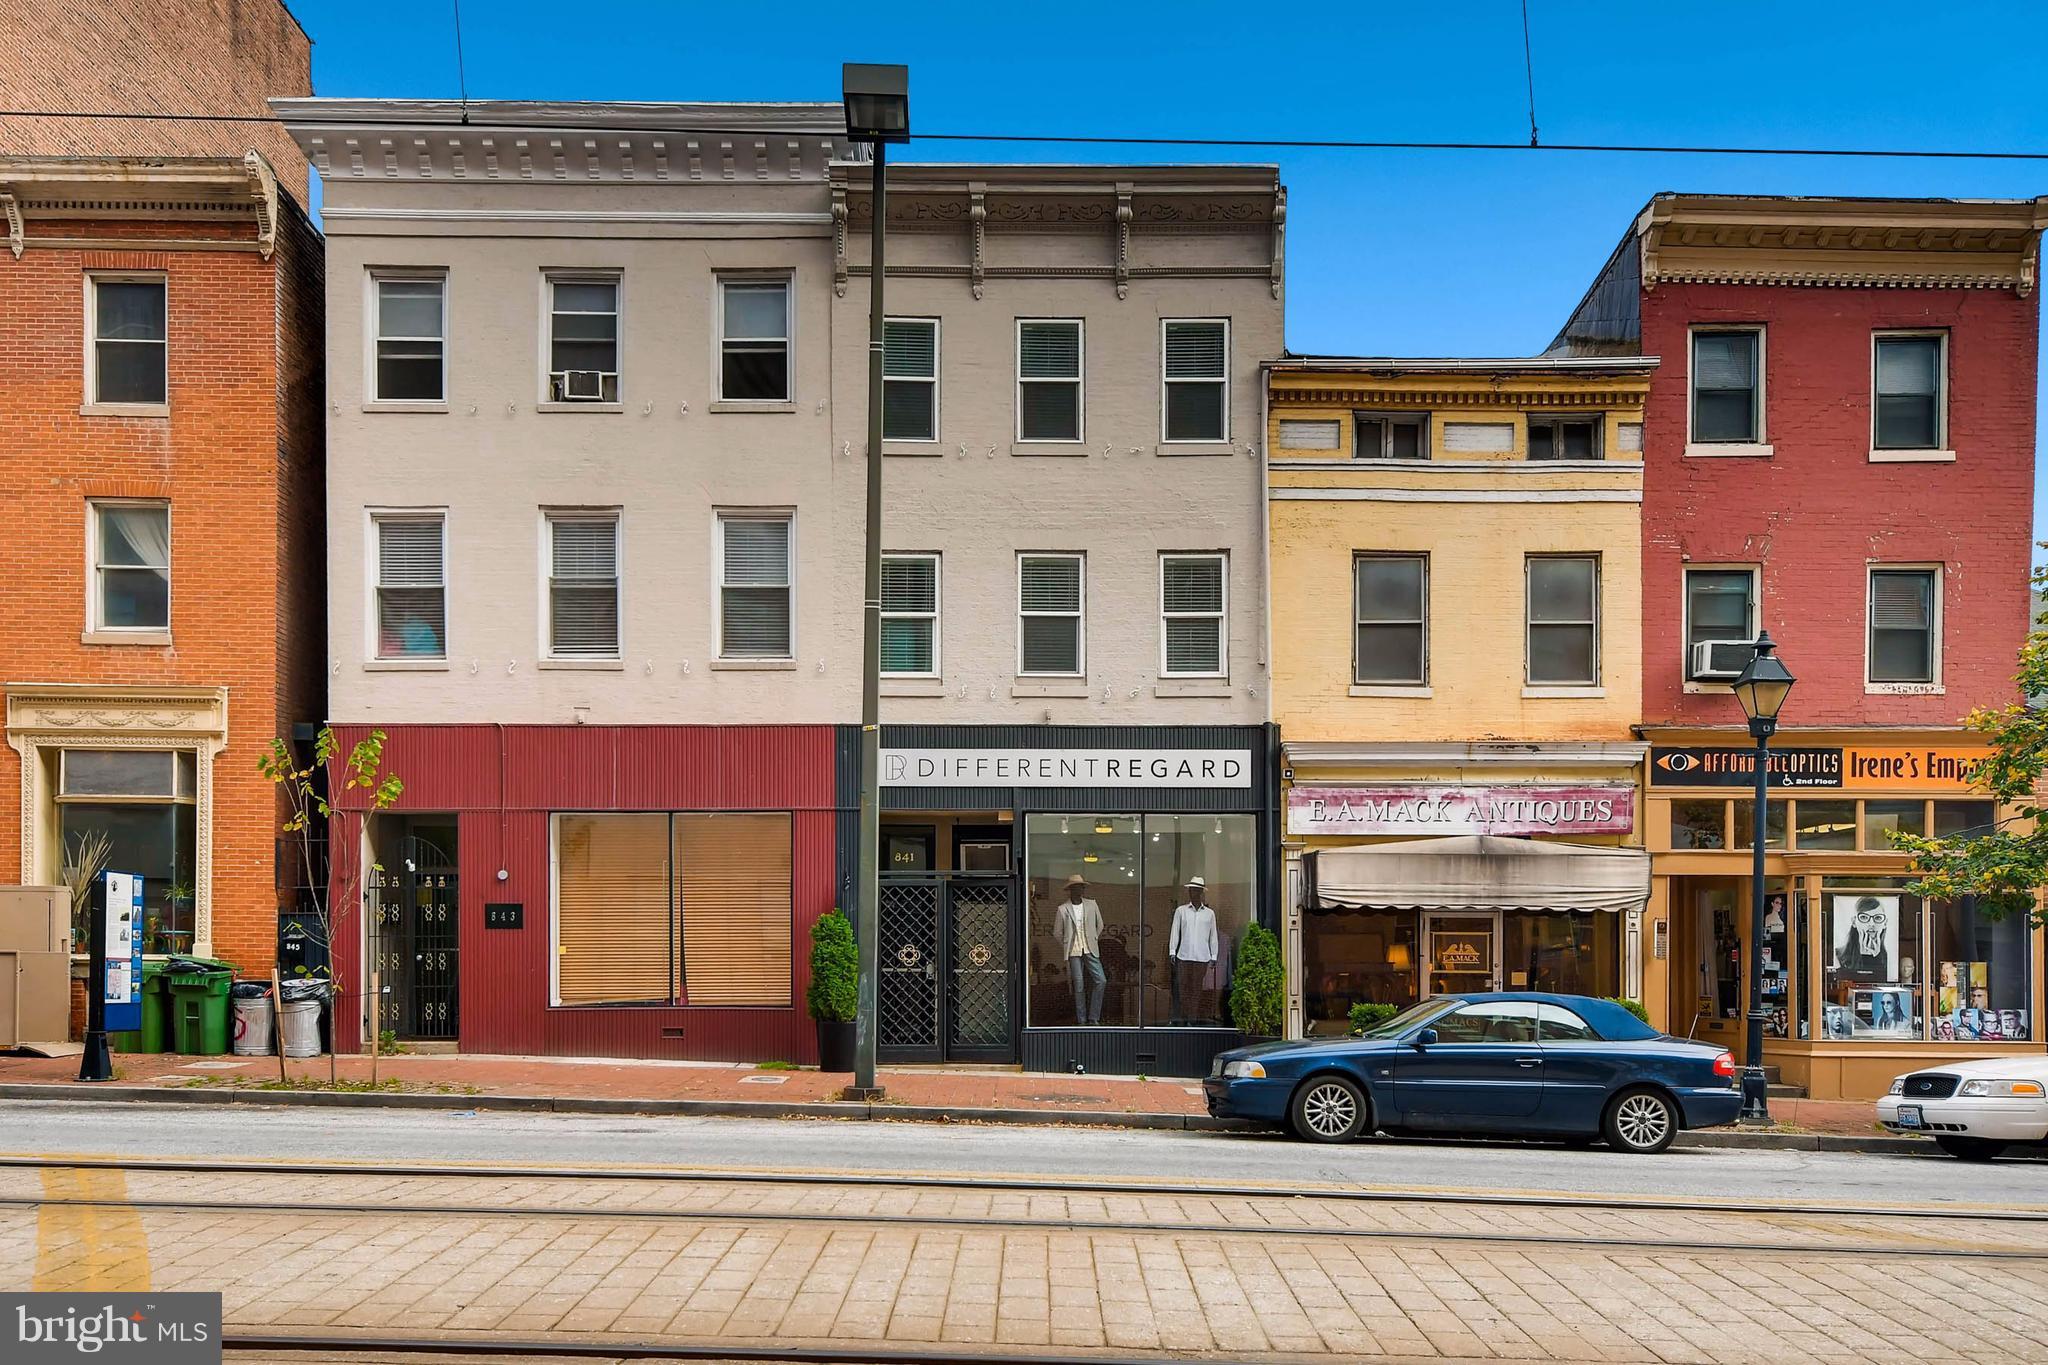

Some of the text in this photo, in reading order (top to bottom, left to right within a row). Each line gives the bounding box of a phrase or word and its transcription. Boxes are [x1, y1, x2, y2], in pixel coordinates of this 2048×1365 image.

[1851, 751, 1919, 778] Irene's
[1465, 799, 1613, 826] ANTIQUES
[894, 852, 914, 863] 841
[286, 943, 300, 951] 845
